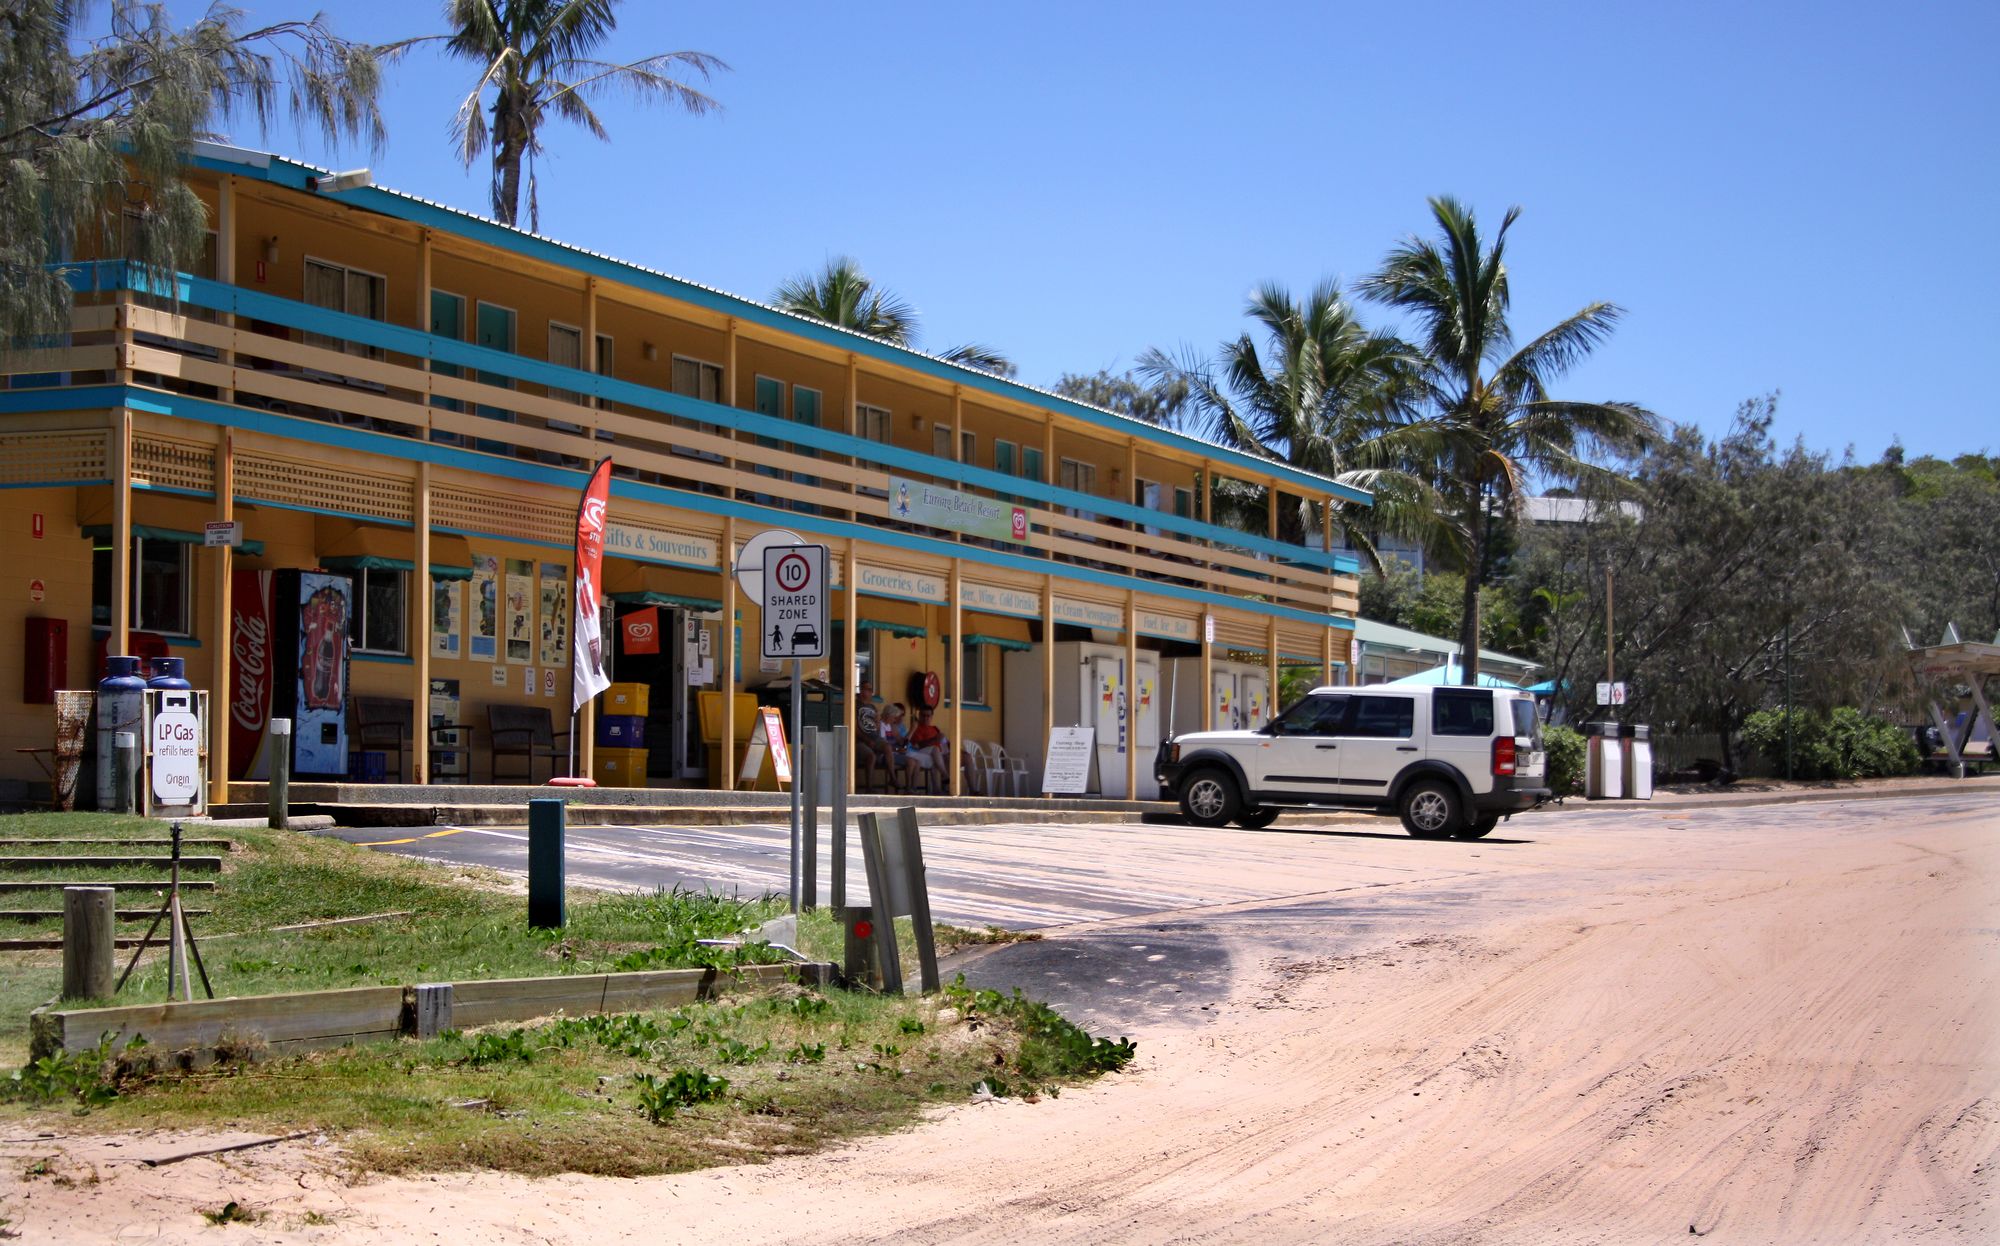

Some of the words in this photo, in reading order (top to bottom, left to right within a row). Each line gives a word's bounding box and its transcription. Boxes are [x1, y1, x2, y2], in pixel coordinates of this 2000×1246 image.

[923, 487, 952, 512] Eurong
[954, 496, 976, 513] Beach
[978, 502, 1000, 519] Resort
[636, 534, 645, 550] &
[649, 535, 708, 560] Souvenirs
[786, 564, 802, 581] 10
[917, 578, 937, 595] Gas
[771, 595, 816, 606] SHARED
[1015, 594, 1036, 611] Drinks
[779, 609, 808, 620] ZONE
[232, 609, 266, 731] Coca-Cola
[160, 724, 172, 740] LP
[174, 724, 194, 740] Gas
[159, 745, 178, 756] refills
[179, 745, 194, 756] here
[166, 774, 190, 787] Origin
